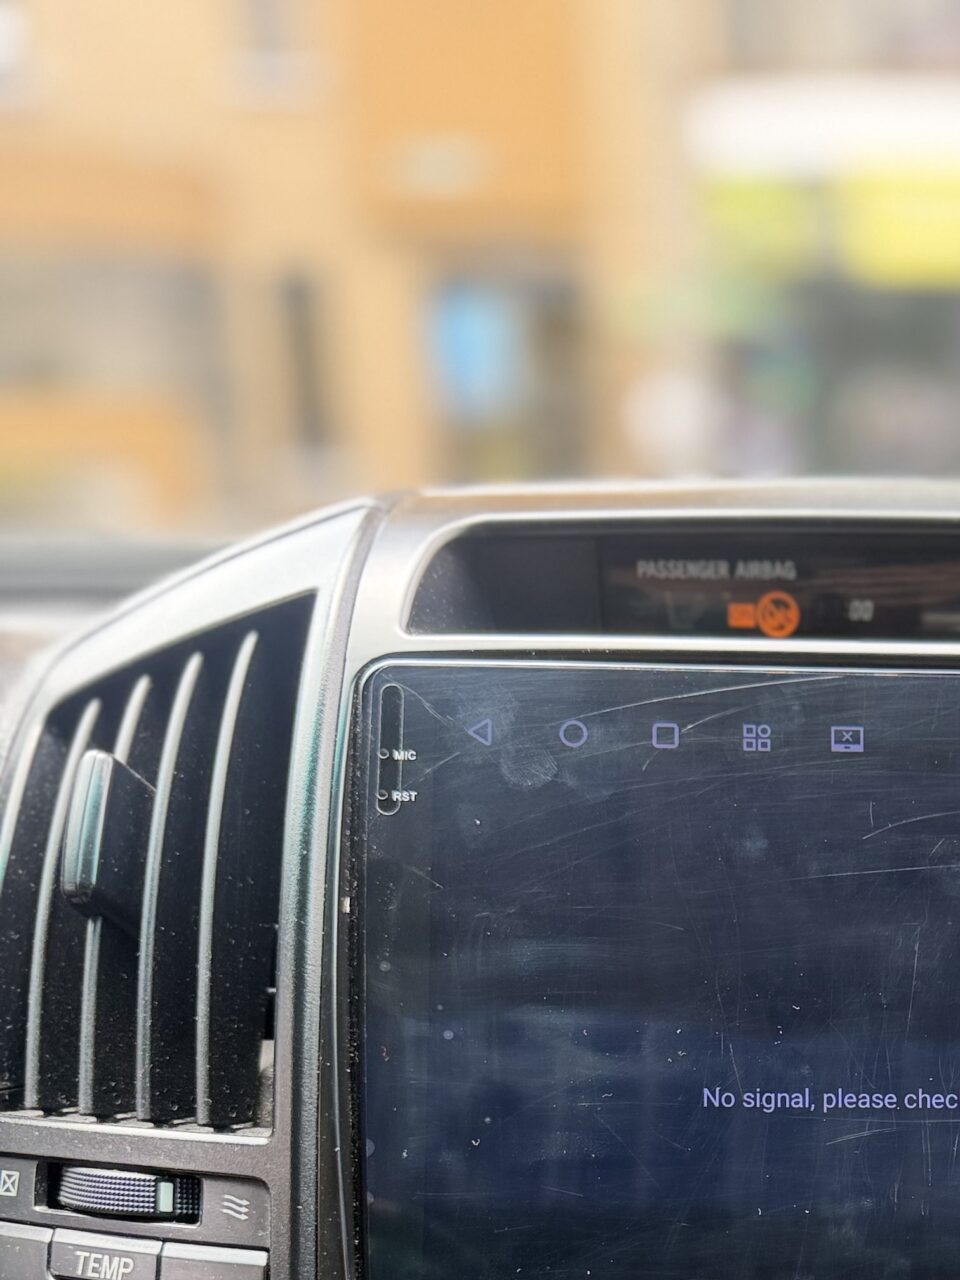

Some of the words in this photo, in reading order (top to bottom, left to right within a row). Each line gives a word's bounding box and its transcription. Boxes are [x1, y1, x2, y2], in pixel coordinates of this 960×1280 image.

[636, 560, 730, 578] PASSENGER
[734, 560, 797, 580] AIRBAG
[393, 750, 416, 760] MIC
[392, 791, 417, 801] RST
[703, 1088, 735, 1107] No
[742, 1088, 816, 1112] signal,
[823, 1088, 897, 1112] please
[75, 1251, 134, 1280] TEMP
